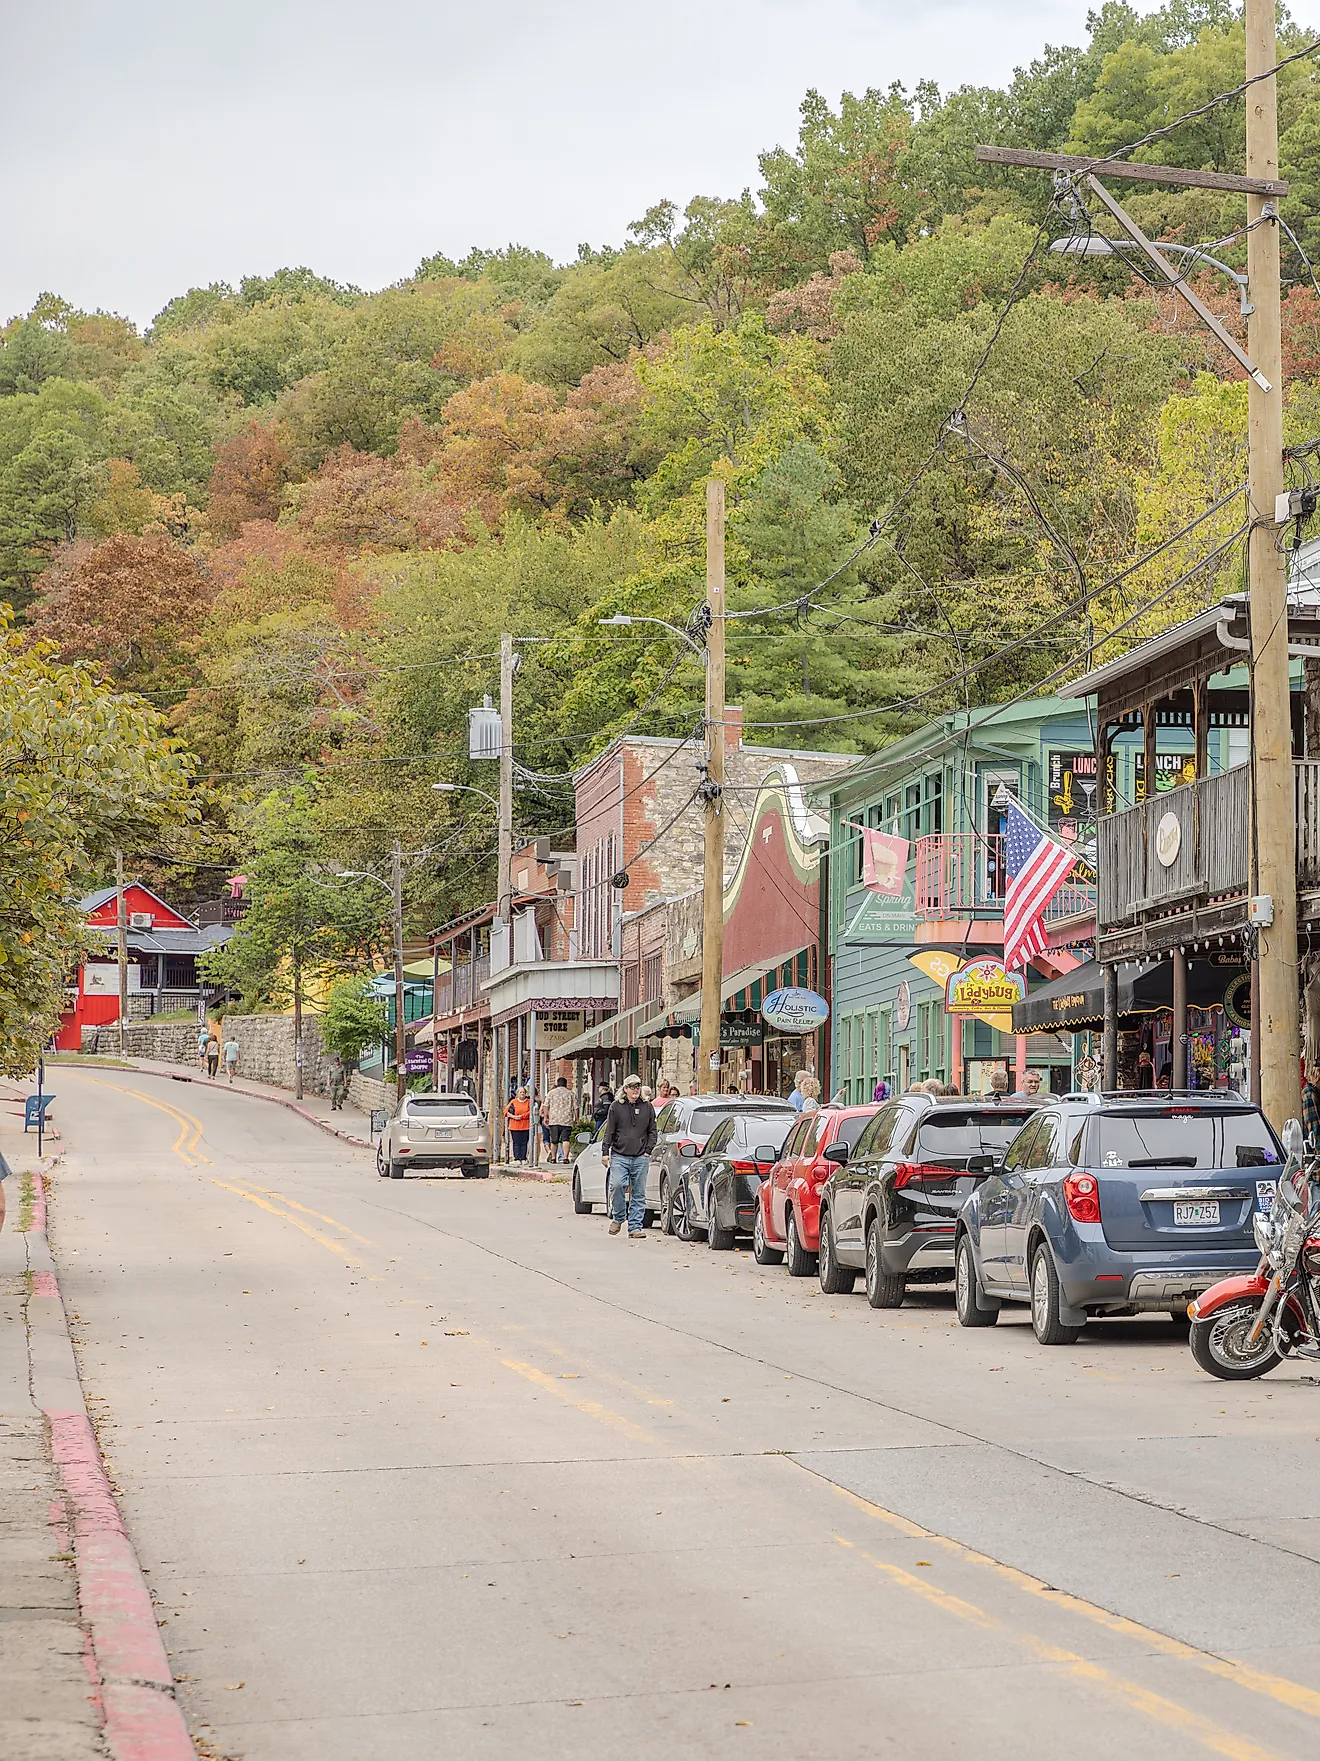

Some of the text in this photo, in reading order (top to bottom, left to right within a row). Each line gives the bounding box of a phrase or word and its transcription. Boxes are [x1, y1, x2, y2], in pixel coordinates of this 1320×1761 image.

[1073, 757, 1097, 774] LUNC
[1137, 755, 1181, 770] LNCH
[1050, 754, 1061, 788] Brunch
[875, 894, 912, 909] Spring
[859, 923, 914, 931] EATS & DRIN
[552, 1011, 580, 1020] STREET
[543, 1023, 568, 1031] STORE
[729, 1026, 760, 1037] Paradise
